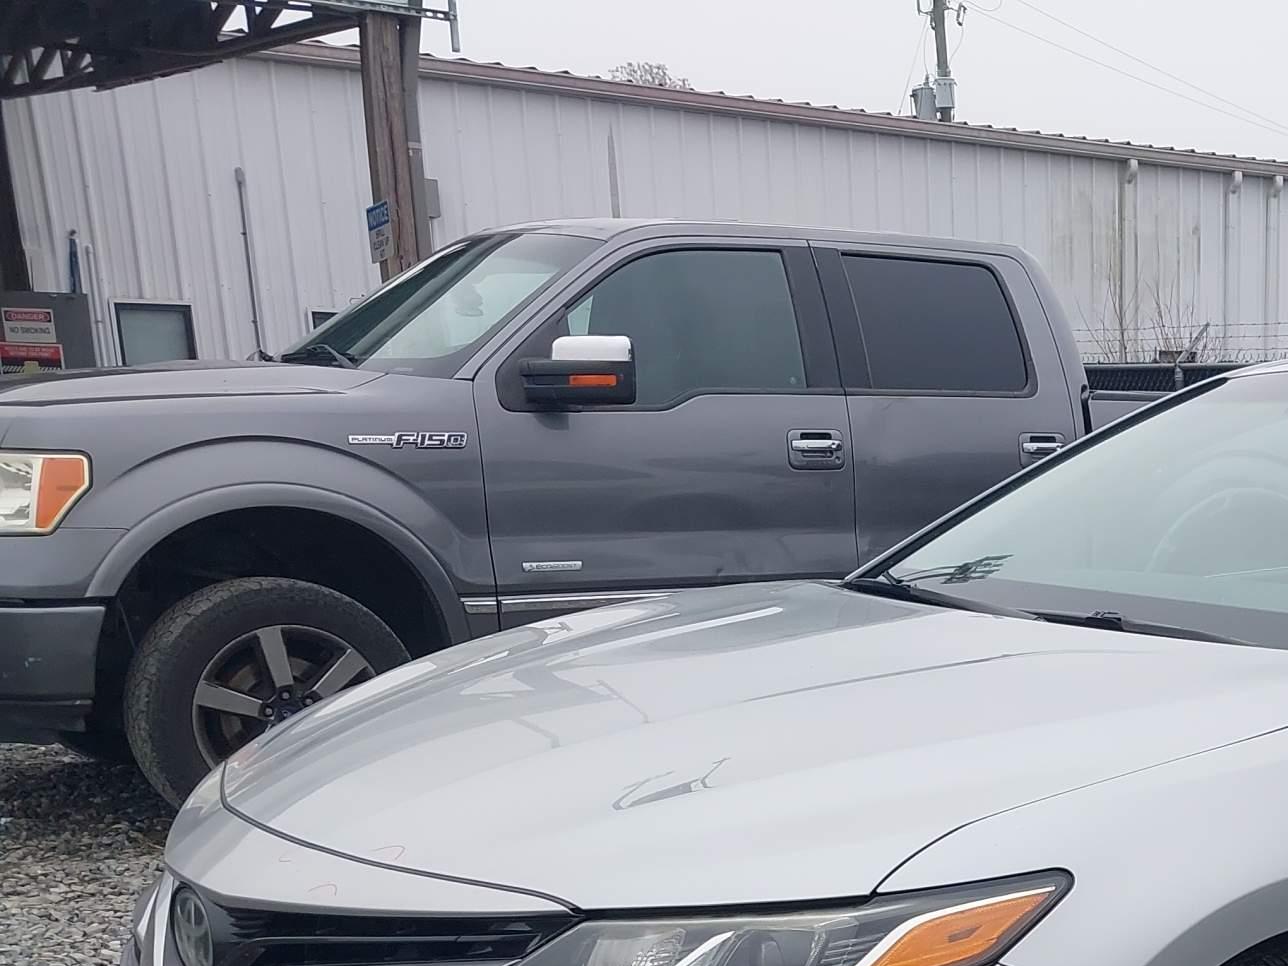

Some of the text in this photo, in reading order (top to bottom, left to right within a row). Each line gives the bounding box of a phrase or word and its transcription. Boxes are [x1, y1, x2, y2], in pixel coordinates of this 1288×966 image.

[367, 204, 389, 226] NOTICE
[11, 312, 45, 320] DANGER
[10, 326, 51, 335] NO SMOKING
